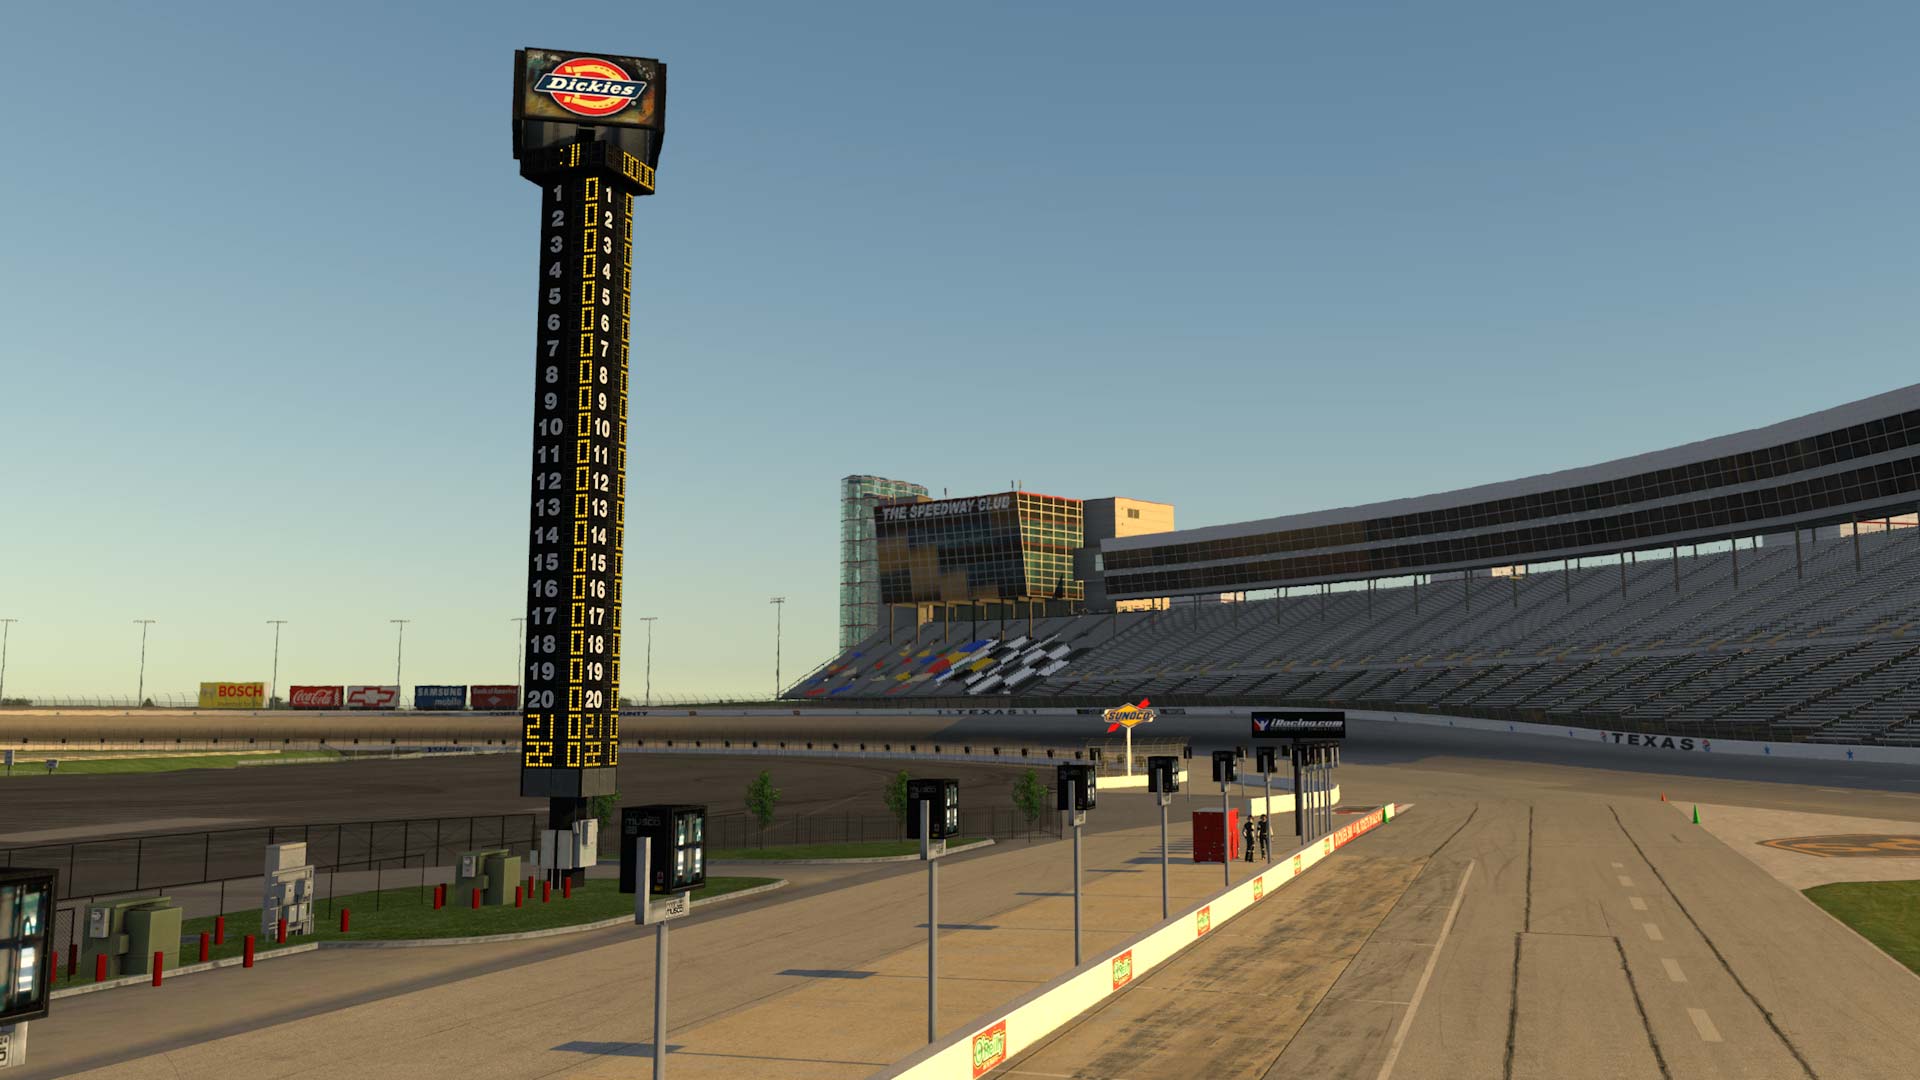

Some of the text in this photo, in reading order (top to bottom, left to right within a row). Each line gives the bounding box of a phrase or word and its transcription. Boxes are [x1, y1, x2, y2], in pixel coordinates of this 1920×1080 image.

[546, 77, 636, 96] Dickies
[553, 185, 562, 201] 1
[605, 188, 612, 202] 1
[551, 210, 565, 226] 2
[604, 211, 613, 228] 2
[549, 236, 563, 253] 3
[603, 237, 612, 254] 3
[548, 262, 562, 278] 4
[602, 264, 611, 280] 4
[548, 288, 562, 304] 5
[601, 288, 611, 305] 5
[547, 314, 561, 330] 6
[600, 315, 610, 332] 6
[546, 340, 560, 356] 7
[600, 340, 609, 357] 7
[545, 366, 559, 383] 8
[599, 367, 608, 384] 8
[544, 393, 558, 409] 9
[598, 393, 607, 410] 9
[538, 418, 564, 436] 10
[594, 418, 611, 437] 10
[537, 445, 560, 463] 11
[593, 445, 608, 464] 11
[536, 473, 562, 490] 12
[592, 472, 609, 491] 12
[535, 498, 561, 516] 13
[591, 498, 608, 517] 13
[882, 495, 1010, 520] THE SPEEDWAY CLUB
[534, 527, 559, 544] 14
[590, 526, 607, 545] 14
[533, 553, 559, 571] 15
[590, 553, 607, 572] 15
[532, 580, 558, 597] 16
[589, 579, 606, 598] 16
[531, 607, 557, 624] 17
[588, 607, 605, 625] 17
[530, 635, 556, 653] 18
[587, 635, 604, 653] 18
[529, 662, 555, 680] 19
[586, 662, 603, 680] 19
[218, 685, 263, 697] BOSCH
[417, 687, 462, 697] SAMSUNG
[527, 690, 555, 708] 20
[585, 690, 603, 708] 20
[1108, 711, 1150, 721] SUNOCO
[1270, 718, 1343, 728] iRacing.com
[527, 714, 554, 739] 21
[585, 714, 602, 739] 21
[1612, 733, 1694, 750] TEXAS
[526, 741, 553, 767] 22
[584, 741, 601, 767] 22
